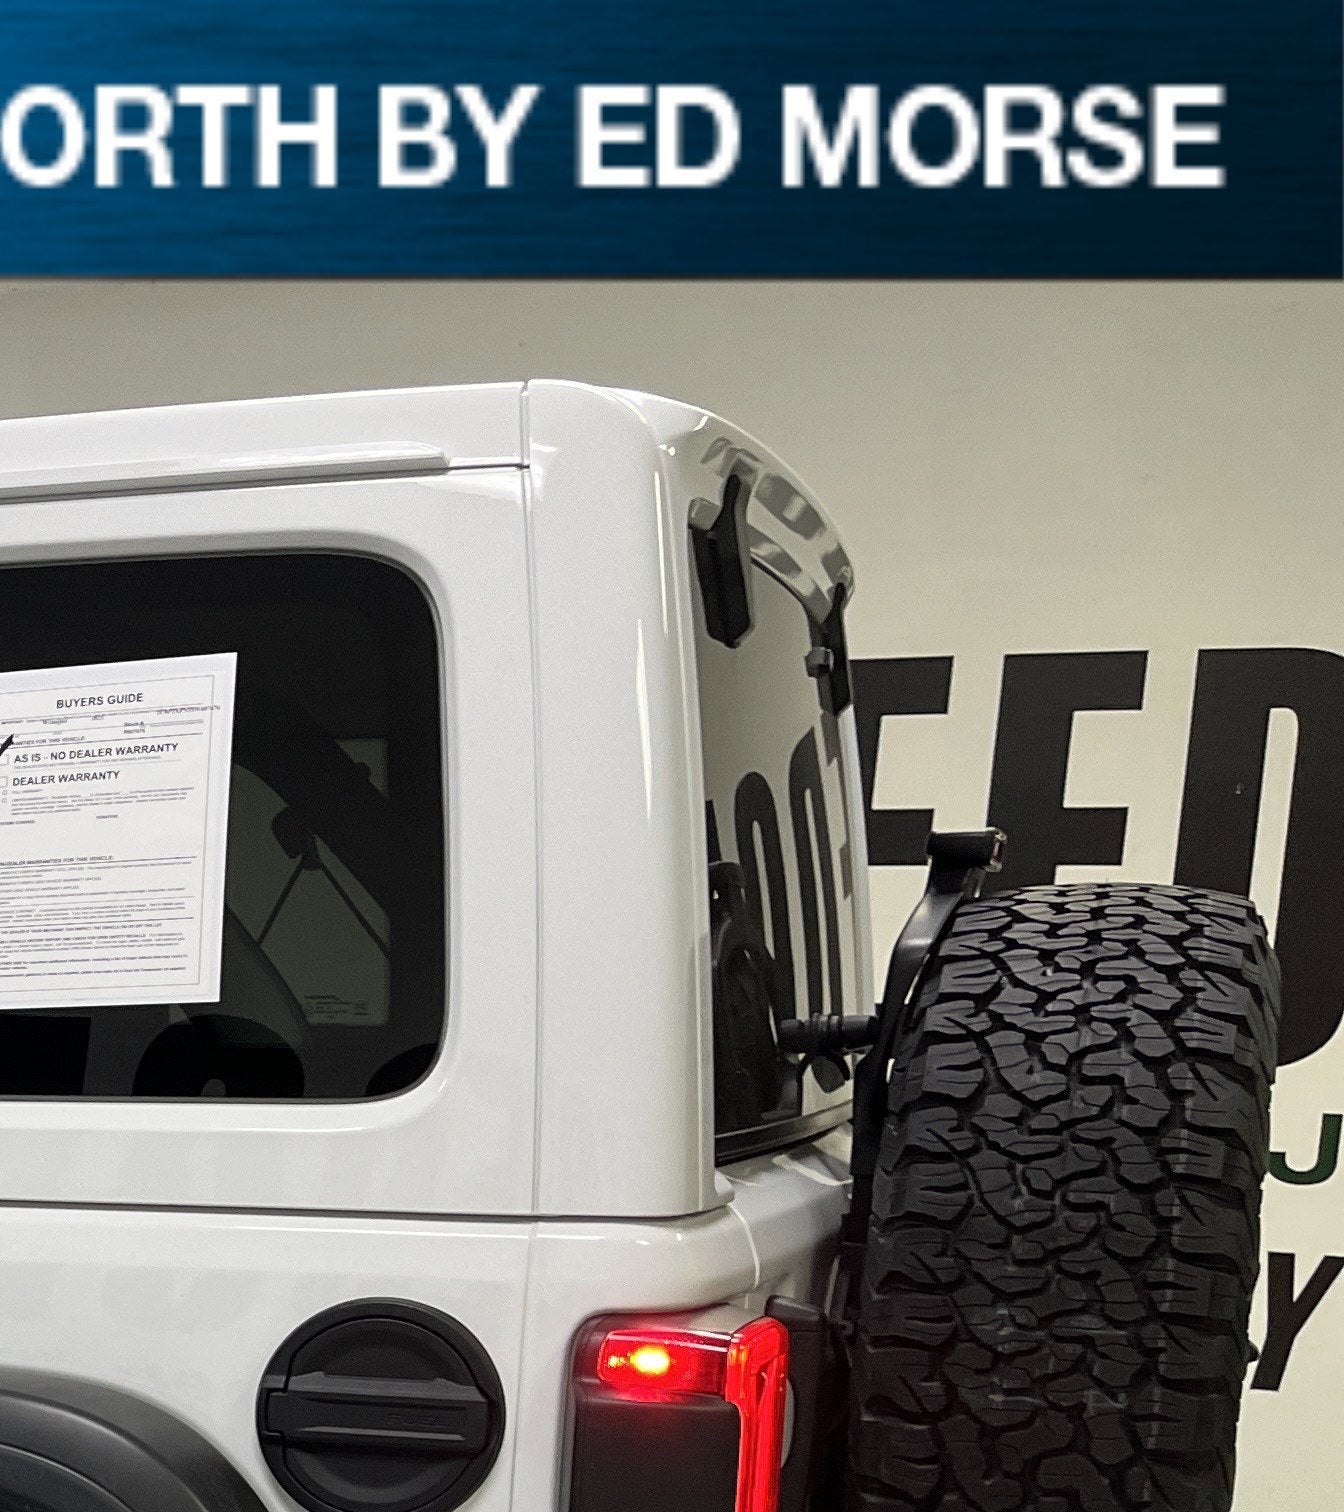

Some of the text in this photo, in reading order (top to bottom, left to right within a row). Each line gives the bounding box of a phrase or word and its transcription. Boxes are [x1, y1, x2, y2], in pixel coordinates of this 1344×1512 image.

[56, 692, 144, 709] BUYERS GUIDE
[14, 754, 28, 763] AS
[31, 753, 41, 762] IS
[50, 751, 66, 761] NO
[69, 748, 112, 759] DEALER
[116, 743, 179, 755] WARRANTY
[12, 771, 120, 787] DEALER WARRANTY
